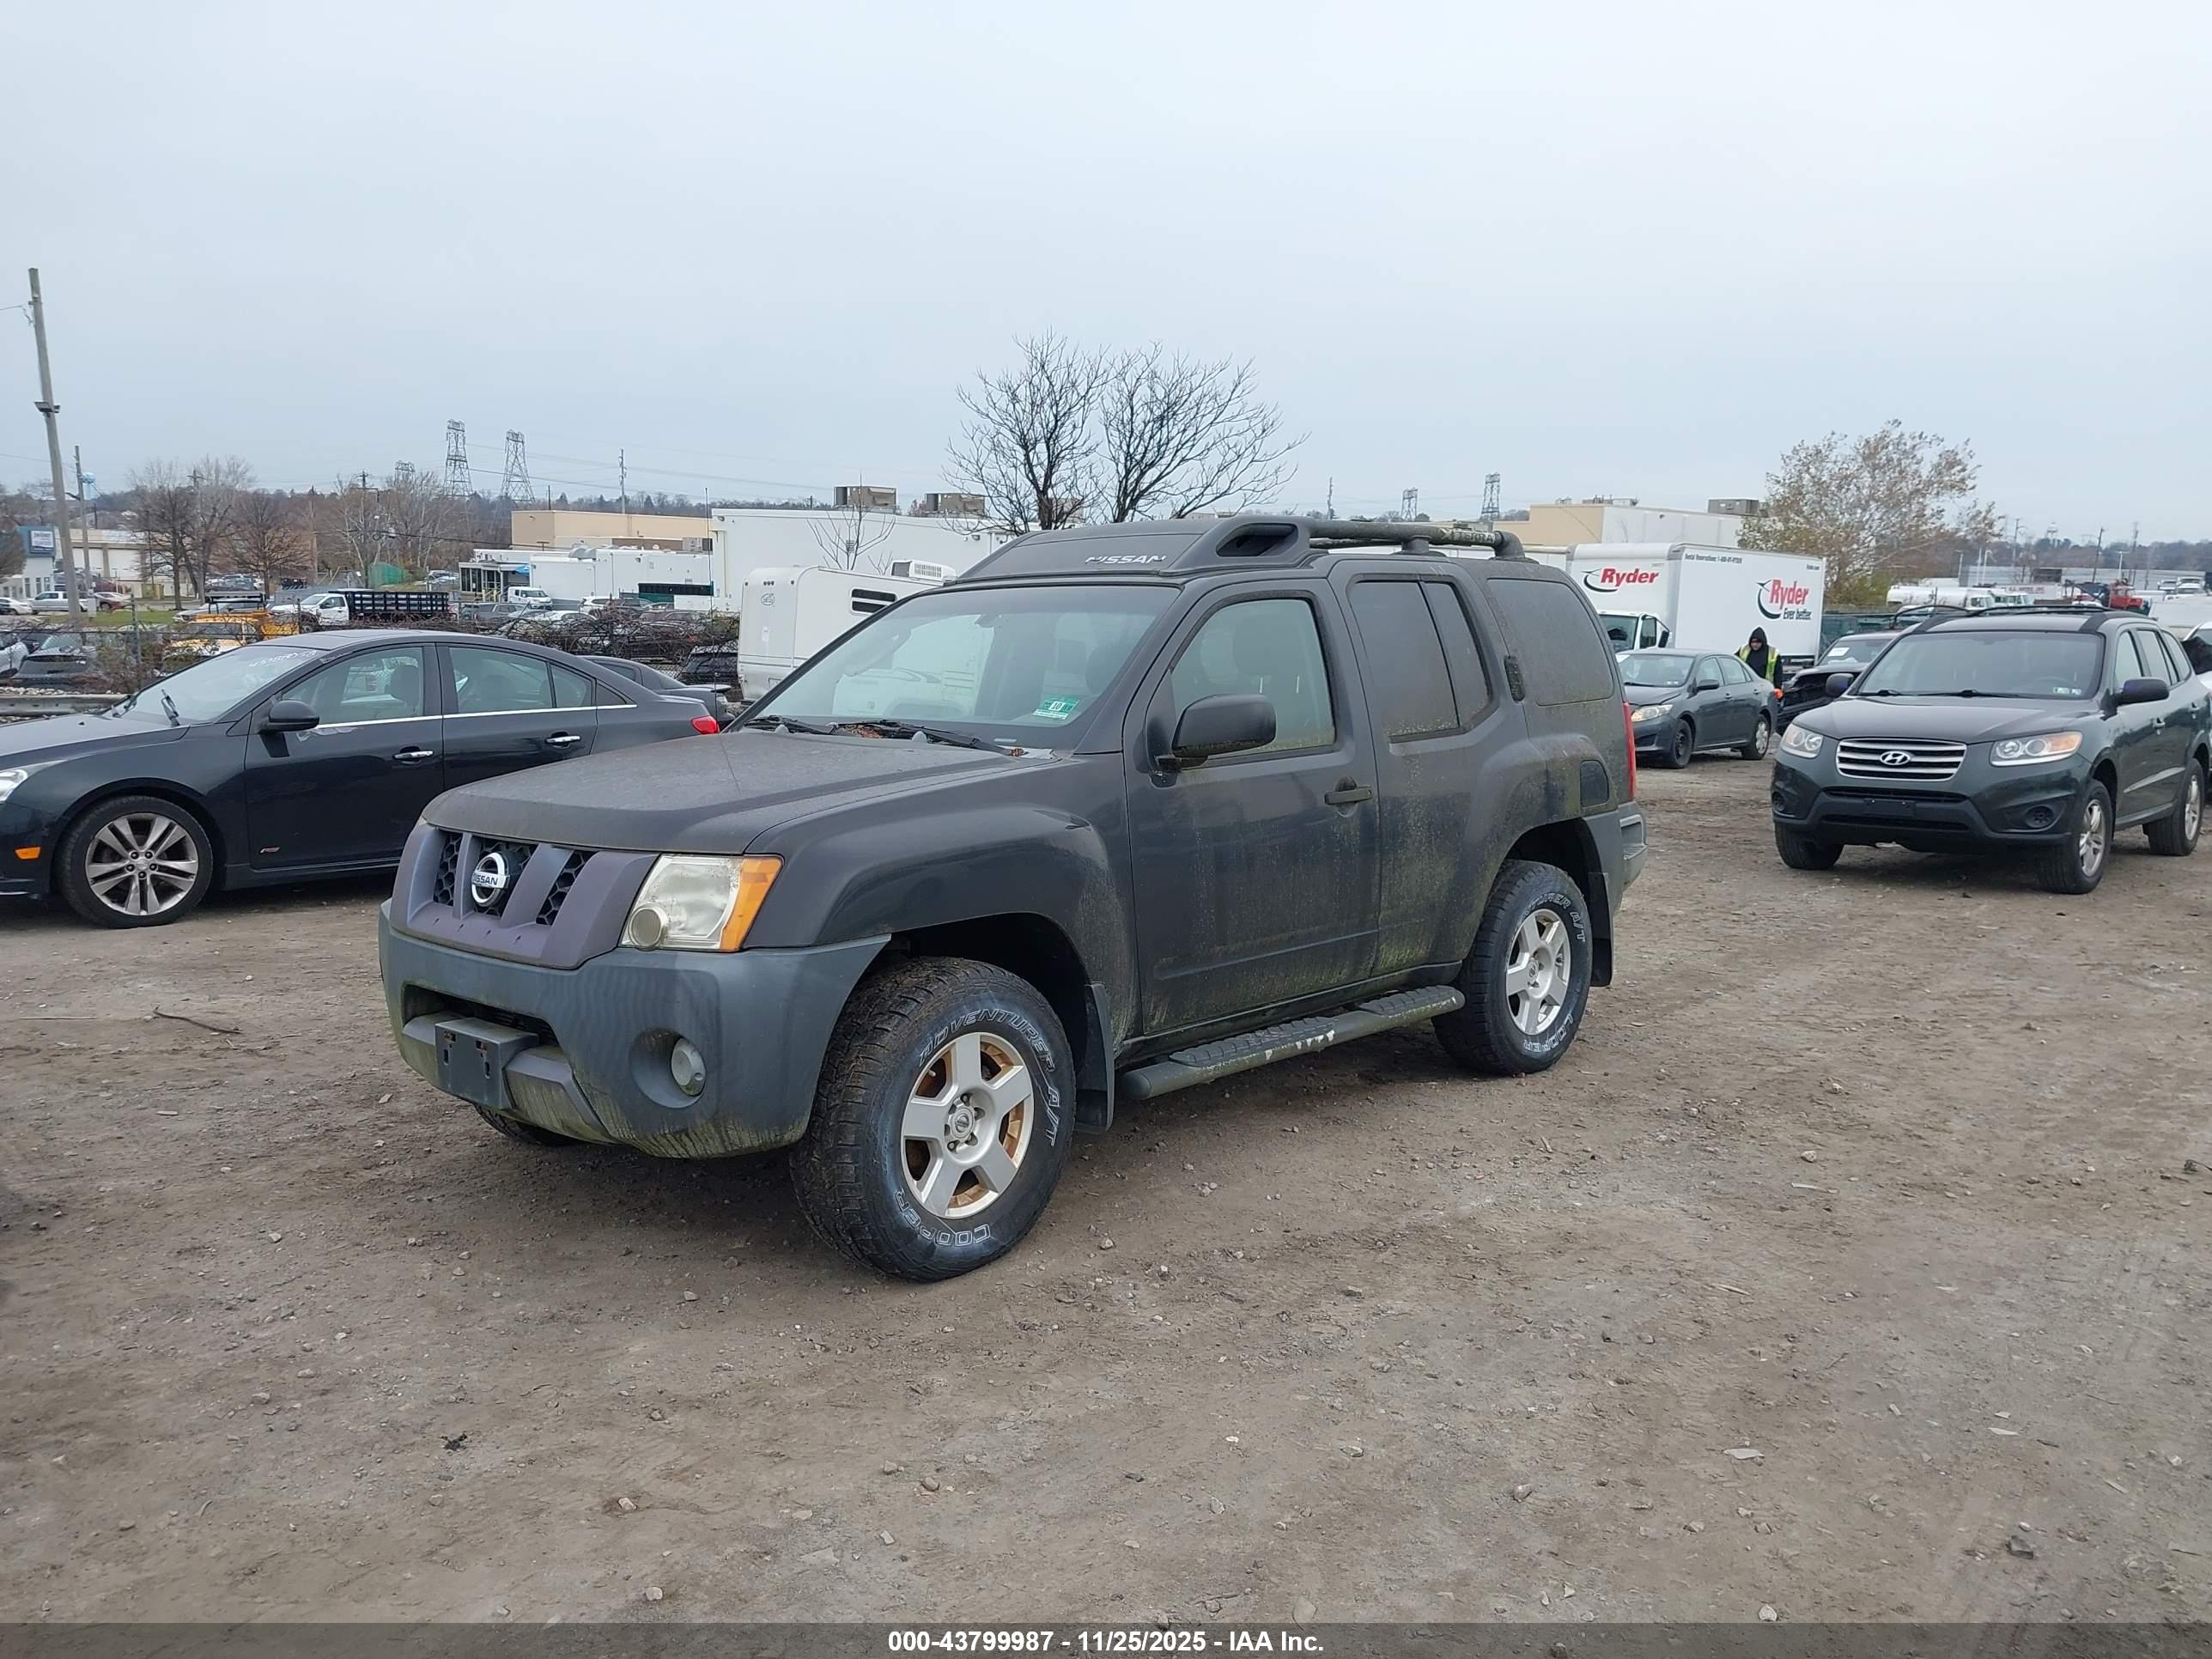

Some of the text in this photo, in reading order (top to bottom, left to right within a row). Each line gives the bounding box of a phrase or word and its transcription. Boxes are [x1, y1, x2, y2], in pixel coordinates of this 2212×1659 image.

[1085, 555, 1168, 565] NISSAN
[1601, 568, 1659, 587] Ryder
[1769, 580, 1809, 610] Ryder
[1783, 608, 1796, 619] Ever
[1571, 912, 1586, 942] A/T
[1524, 1013, 1573, 1054] COOPER
[919, 1008, 1061, 1147] ADVENTURER A/T
[894, 1188, 991, 1248] COOPER
